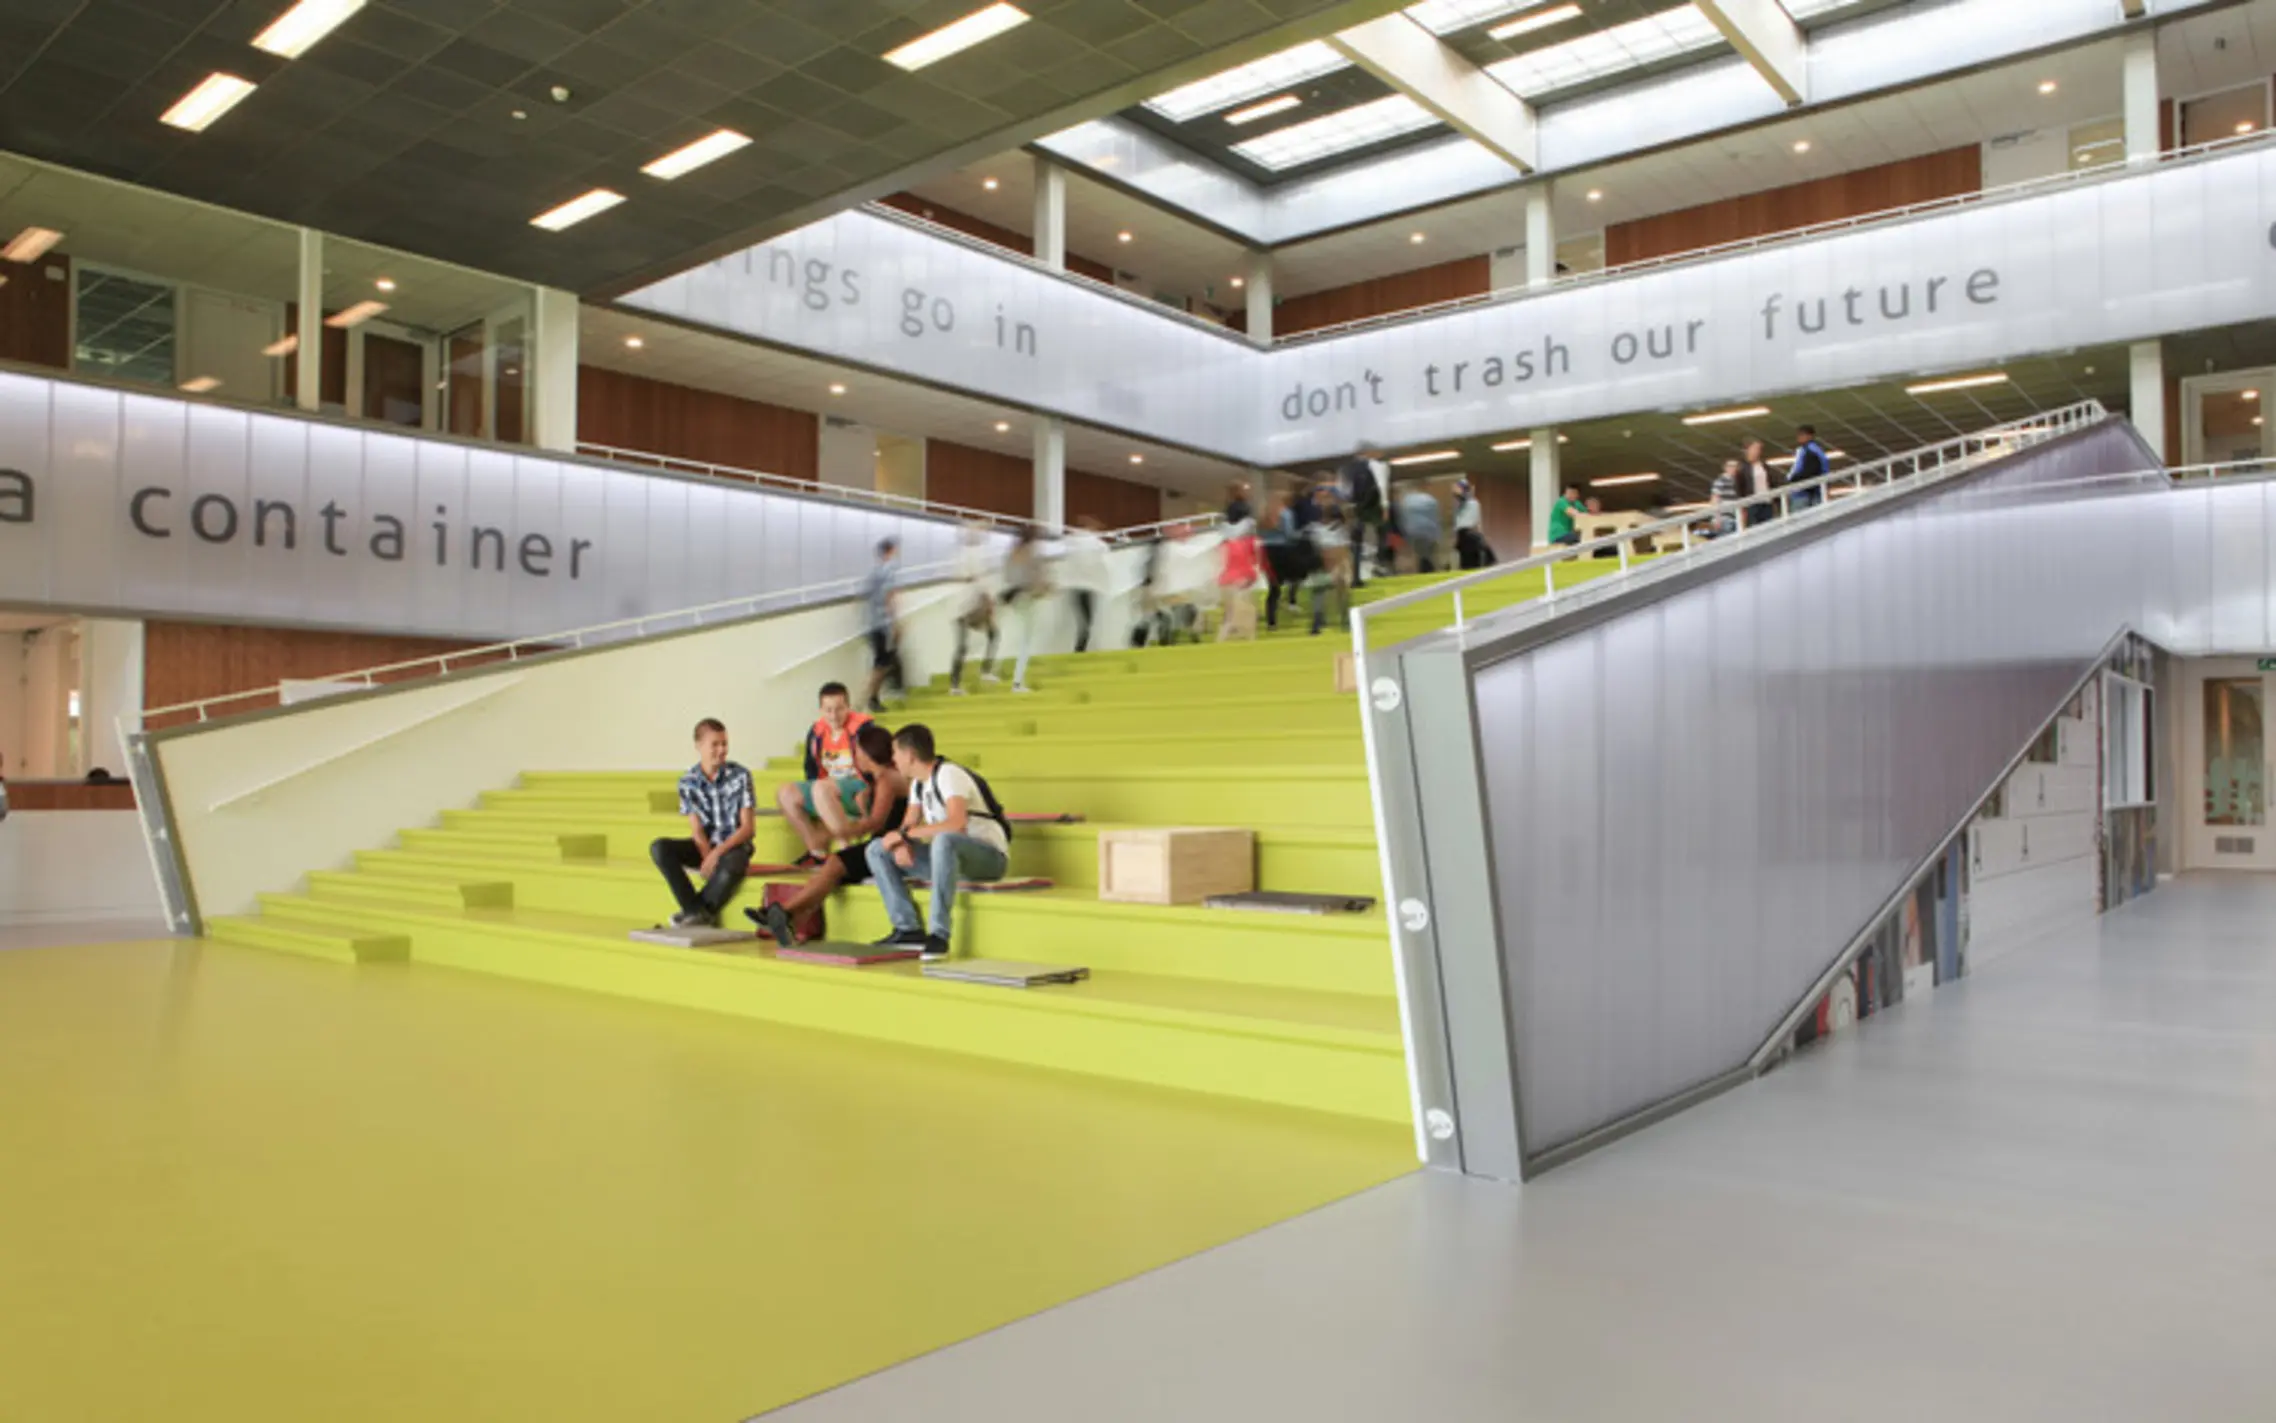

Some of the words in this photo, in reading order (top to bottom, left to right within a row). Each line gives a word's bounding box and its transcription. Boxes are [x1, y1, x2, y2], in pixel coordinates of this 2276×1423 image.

[899, 287, 955, 338] go
[995, 302, 1037, 357] in
[1281, 368, 1385, 421] don't
[1424, 334, 1570, 397] trash
[1610, 317, 1706, 365] our
[1760, 267, 2000, 341] future
[0, 467, 35, 524] a
[129, 485, 593, 580] container
